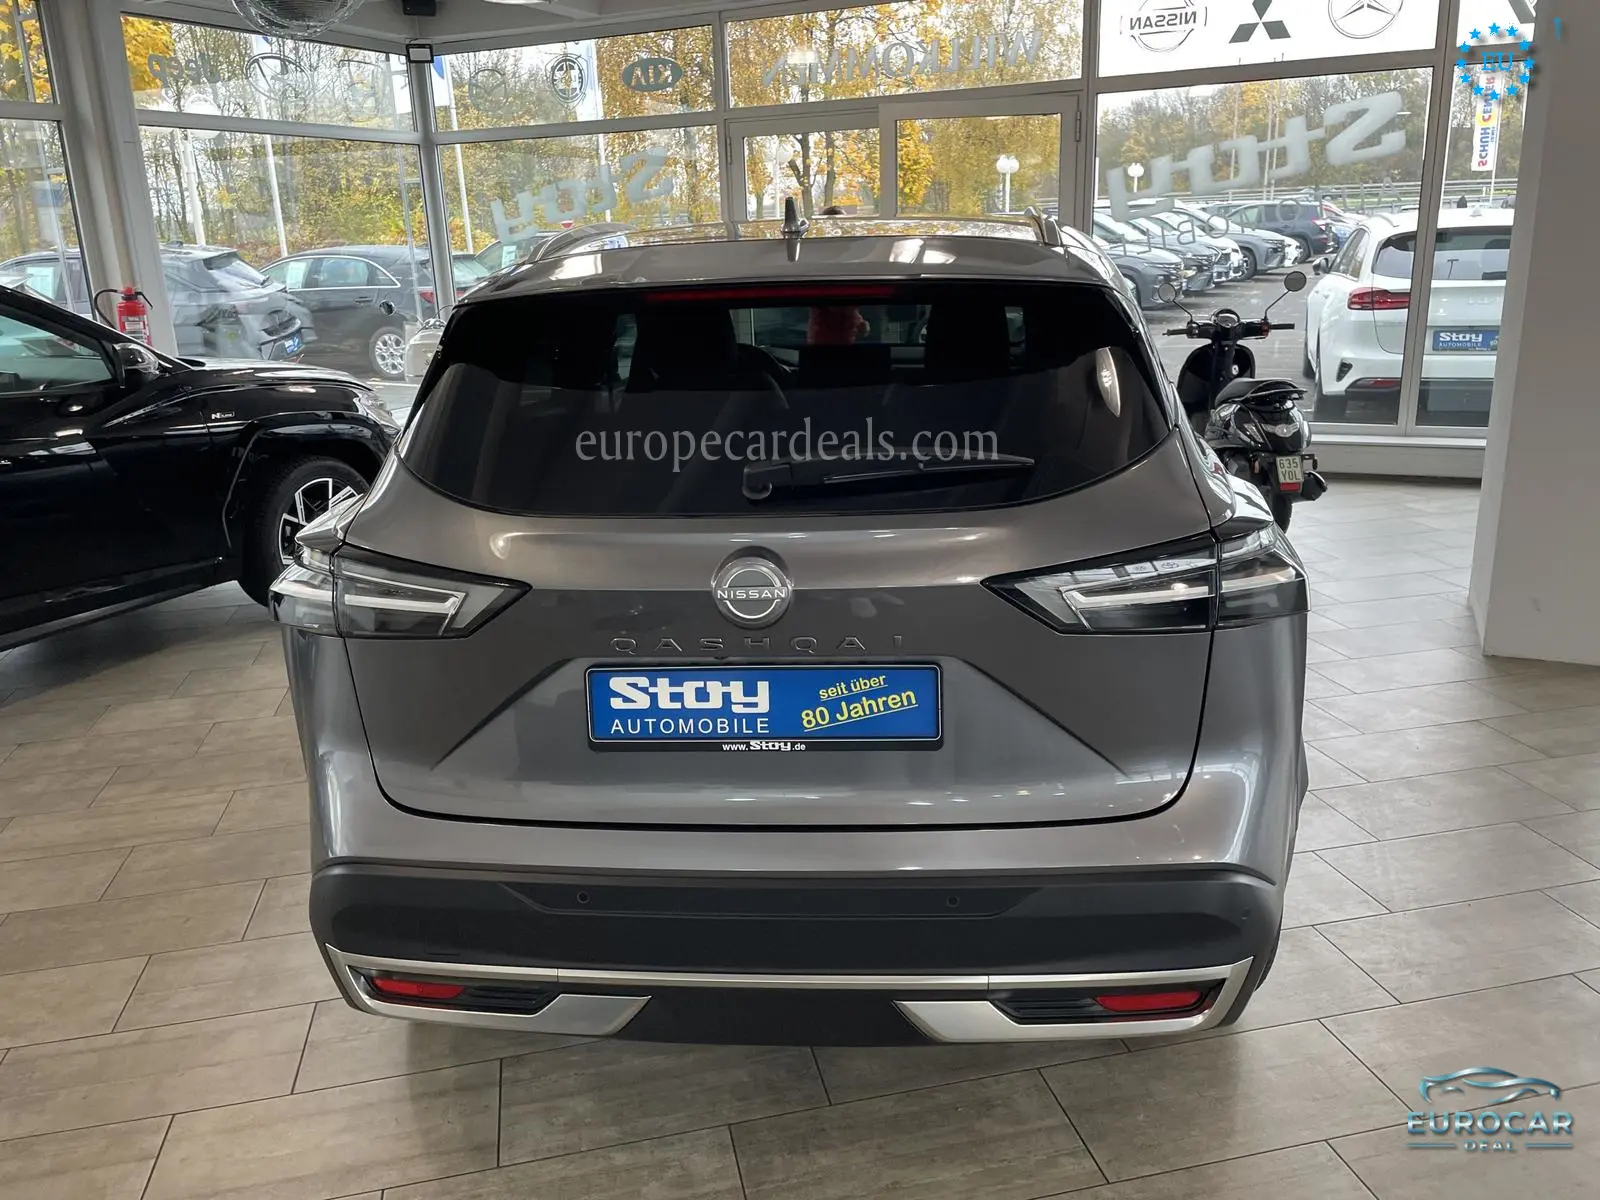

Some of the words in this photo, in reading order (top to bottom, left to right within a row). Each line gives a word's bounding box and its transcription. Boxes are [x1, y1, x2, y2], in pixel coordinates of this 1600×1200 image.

[1439, 332, 1483, 343] Stoy
[1278, 458, 1299, 469] 635
[717, 588, 786, 599] NISSAN
[610, 636, 903, 655] QASHQAI
[818, 681, 848, 699] seit
[850, 674, 887, 693] über
[609, 676, 770, 714] Stoy
[801, 706, 830, 729] 80
[836, 690, 917, 722] Jahren
[610, 718, 770, 734] AUTOMOBILE
[722, 741, 806, 751] www.Stoy.de
